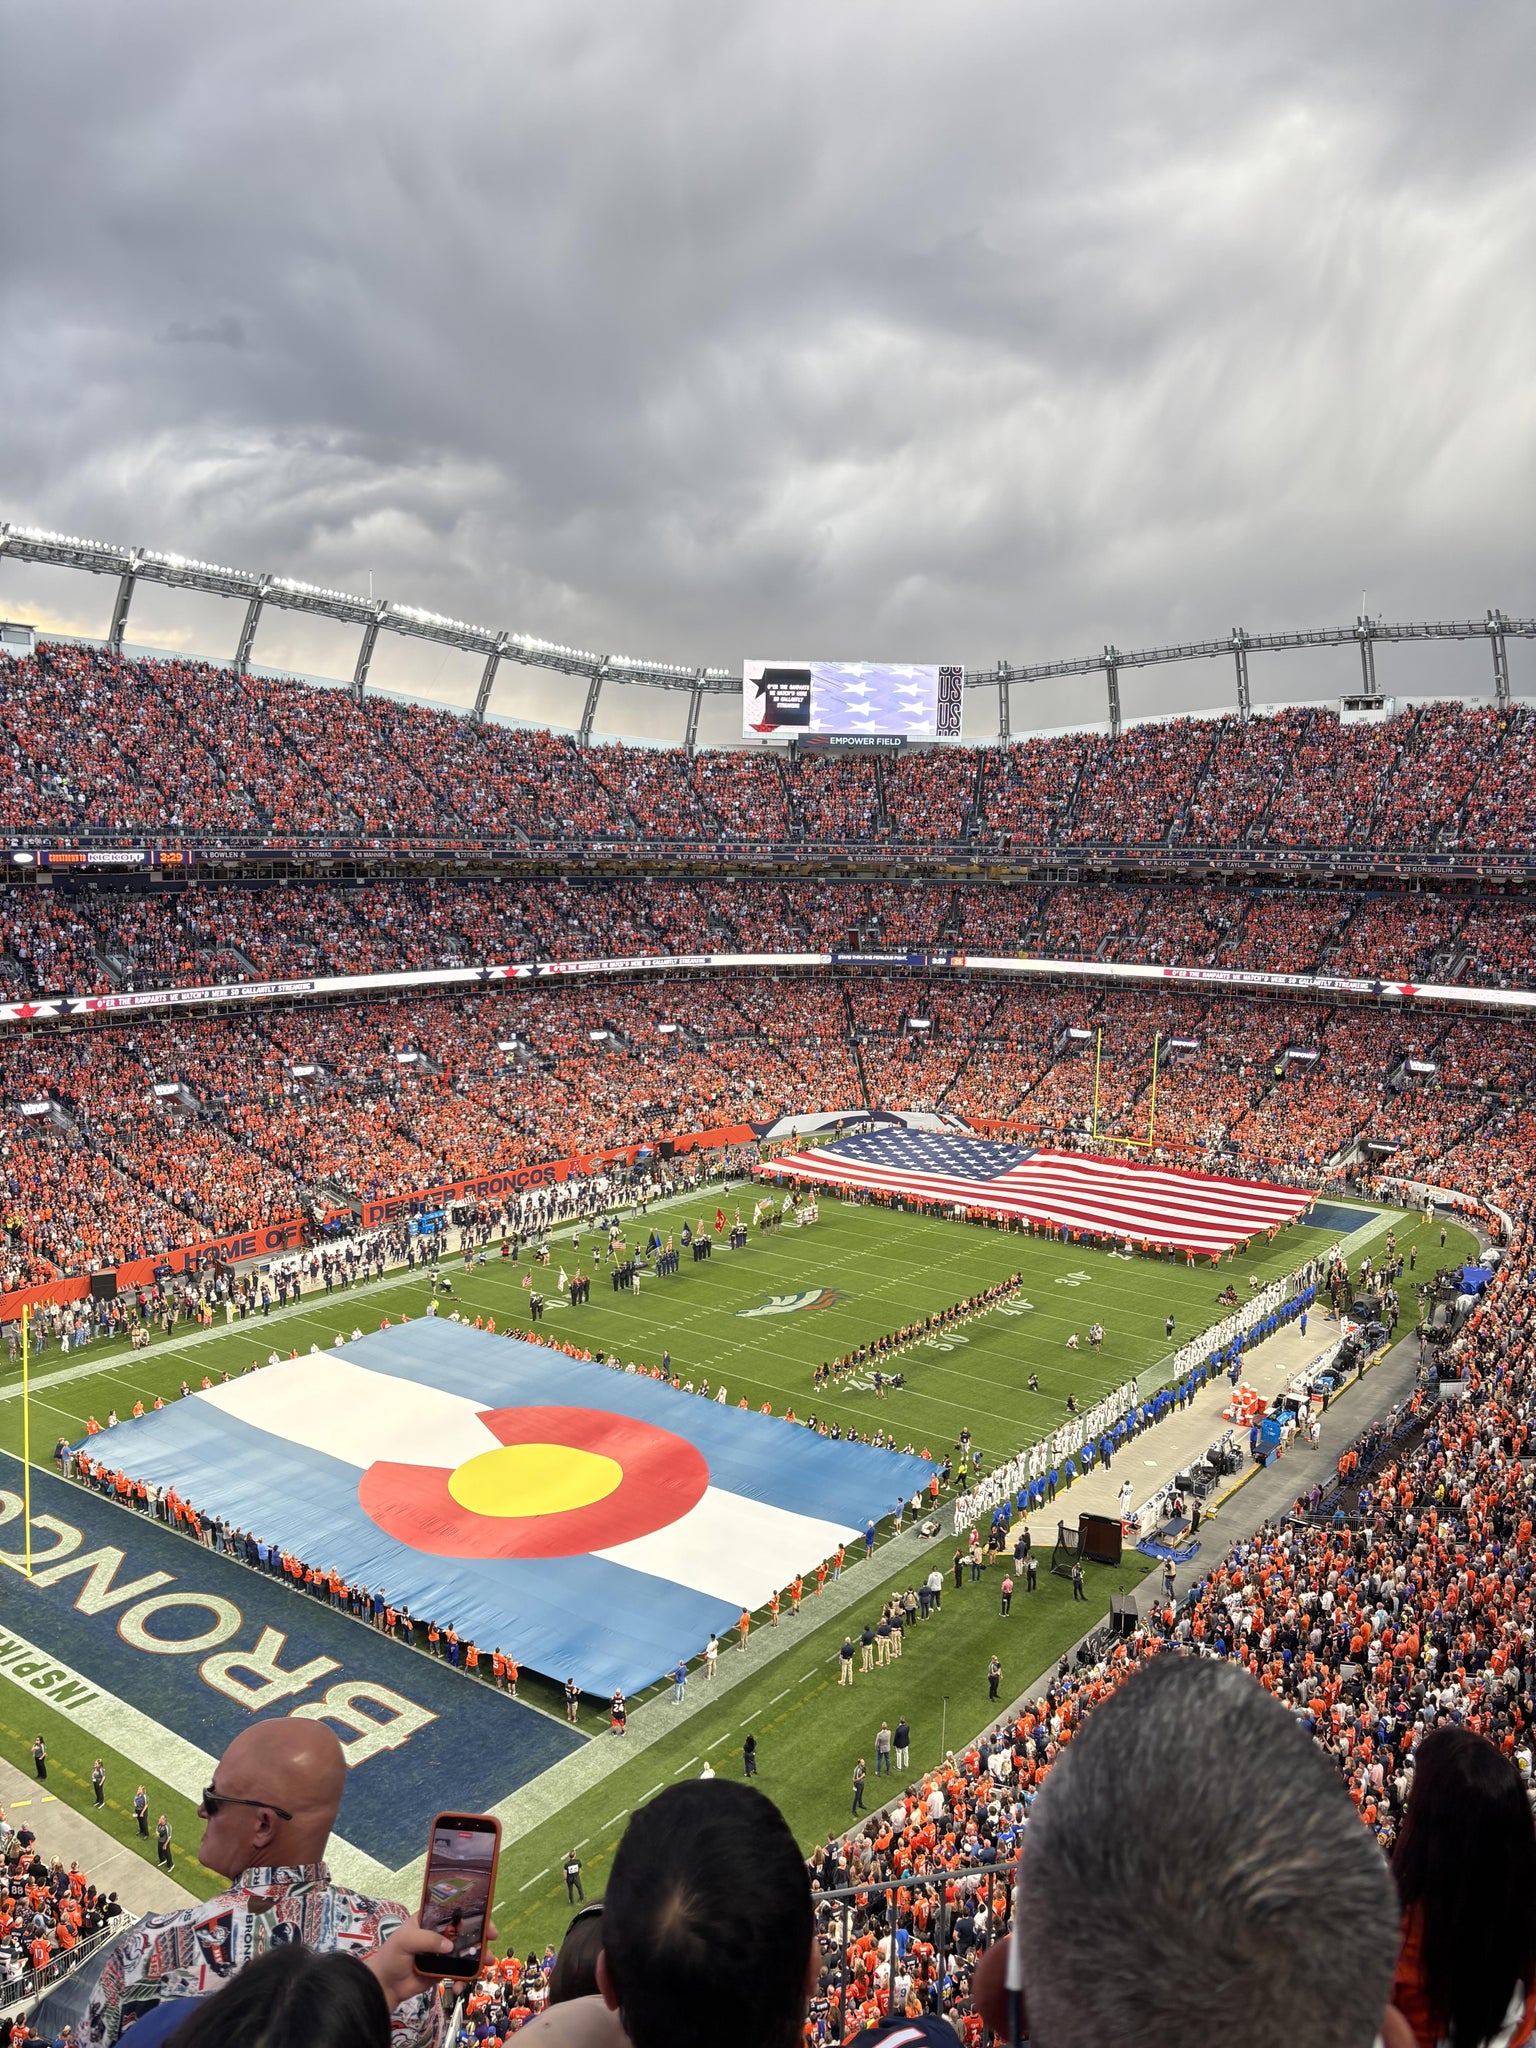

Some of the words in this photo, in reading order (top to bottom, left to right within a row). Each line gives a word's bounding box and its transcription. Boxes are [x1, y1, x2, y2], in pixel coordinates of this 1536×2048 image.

[829, 737, 875, 745] EMPOWER
[876, 738, 901, 746] FIELD
[87, 853, 145, 863] KICKOFF
[160, 852, 183, 862] 3:29
[1202, 971, 1230, 979] RAMPARTS
[1298, 978, 1331, 987] GALLANTLY
[1334, 980, 1369, 989] STREAMING
[97, 999, 115, 1008] O'ER
[118, 998, 132, 1006] THE
[134, 995, 167, 1004] RAMPARTS
[170, 993, 179, 1001] WE
[181, 991, 209, 1001] WATCH'D
[211, 989, 228, 997] WERE
[230, 988, 240, 996] SO
[241, 985, 276, 995] GALLANTLY
[184, 1235, 257, 1270] HOME
[265, 1225, 297, 1249] OF
[1054, 1272, 1092, 1287] 30
[996, 1300, 1034, 1316] 40
[924, 1333, 970, 1351] 50
[0, 1490, 440, 1769] BRONC
[613, 1703, 624, 1713] 24
[11, 1885, 23, 1895] 88
[35, 1948, 44, 1960] 10
[13, 2036, 24, 2047] 89
